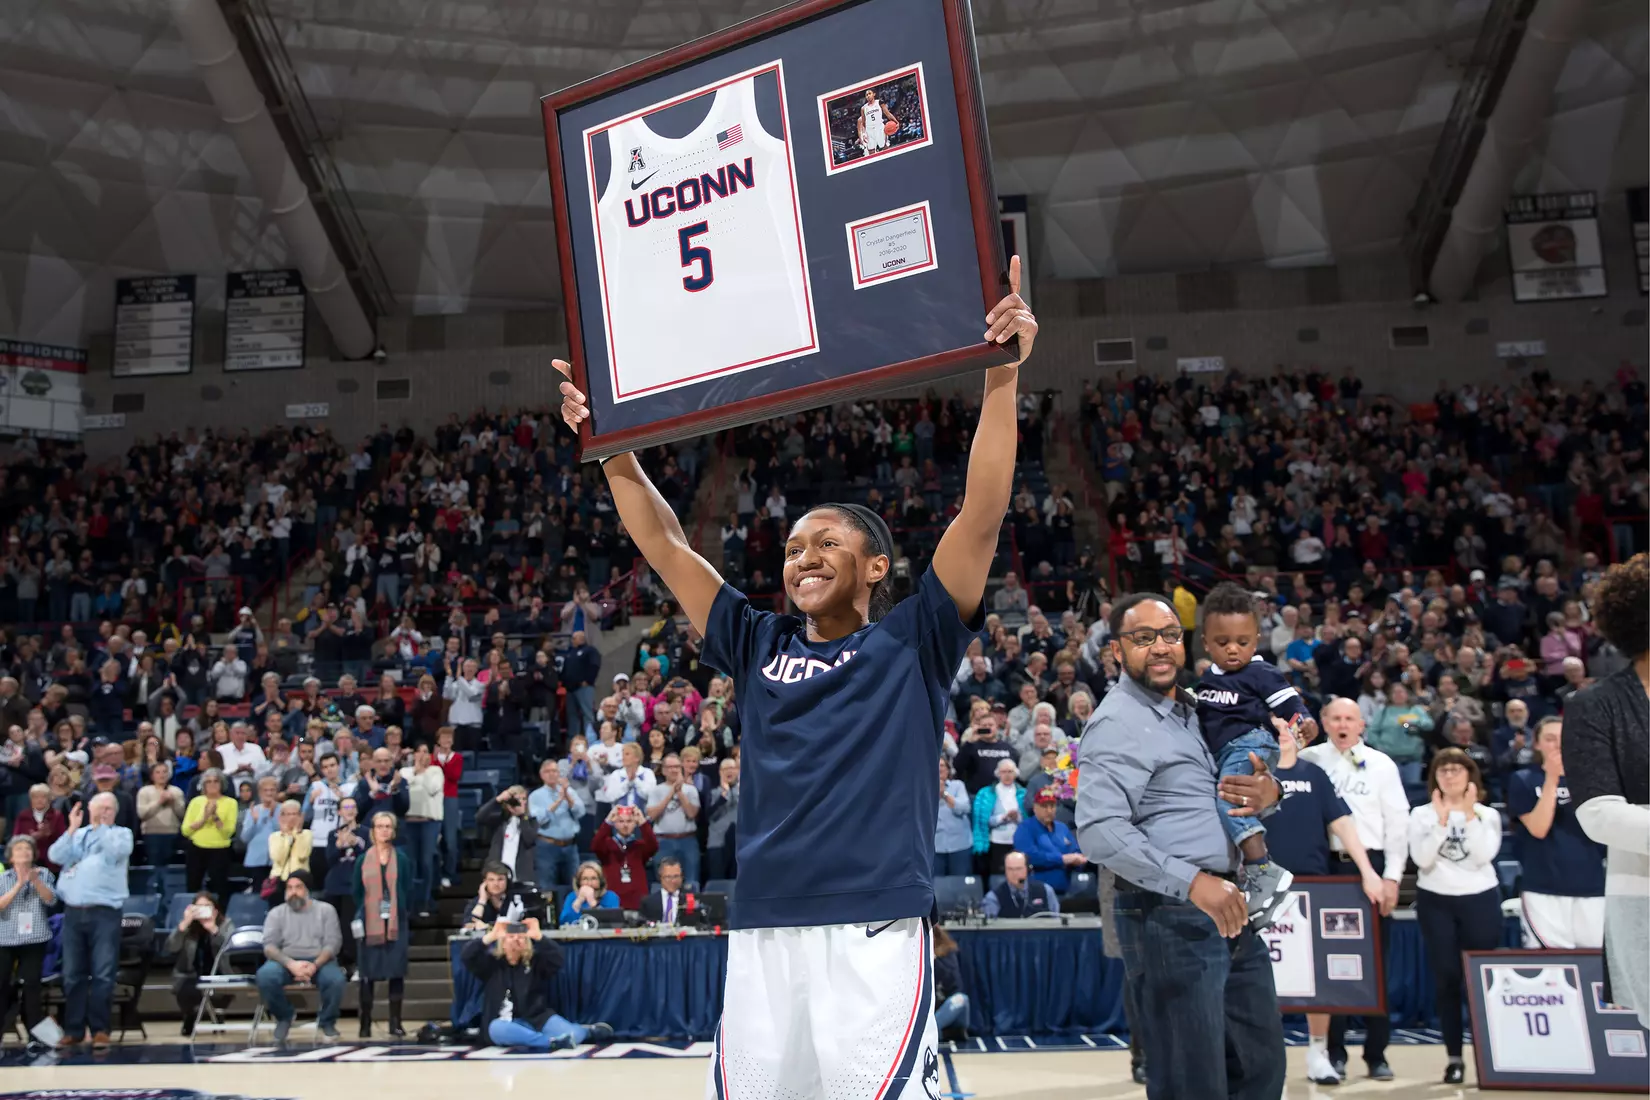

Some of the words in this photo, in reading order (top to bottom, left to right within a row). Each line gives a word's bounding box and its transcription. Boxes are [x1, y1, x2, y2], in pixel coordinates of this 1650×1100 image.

[624, 157, 755, 227] UCONN
[866, 237, 885, 247] Crystal
[885, 229, 917, 242] Dangerfield
[677, 220, 714, 293] 5
[879, 245, 908, 257] 2016-2020
[882, 257, 906, 269] UCONN
[304, 405, 328, 417] 207
[761, 650, 857, 684] UCO
[1198, 689, 1239, 705] CONN
[1280, 780, 1312, 793] ONN
[1268, 940, 1282, 963] 5
[1502, 994, 1564, 1006] UCONN
[1523, 1012, 1550, 1037] 10
[208, 1042, 714, 1062] UCON
